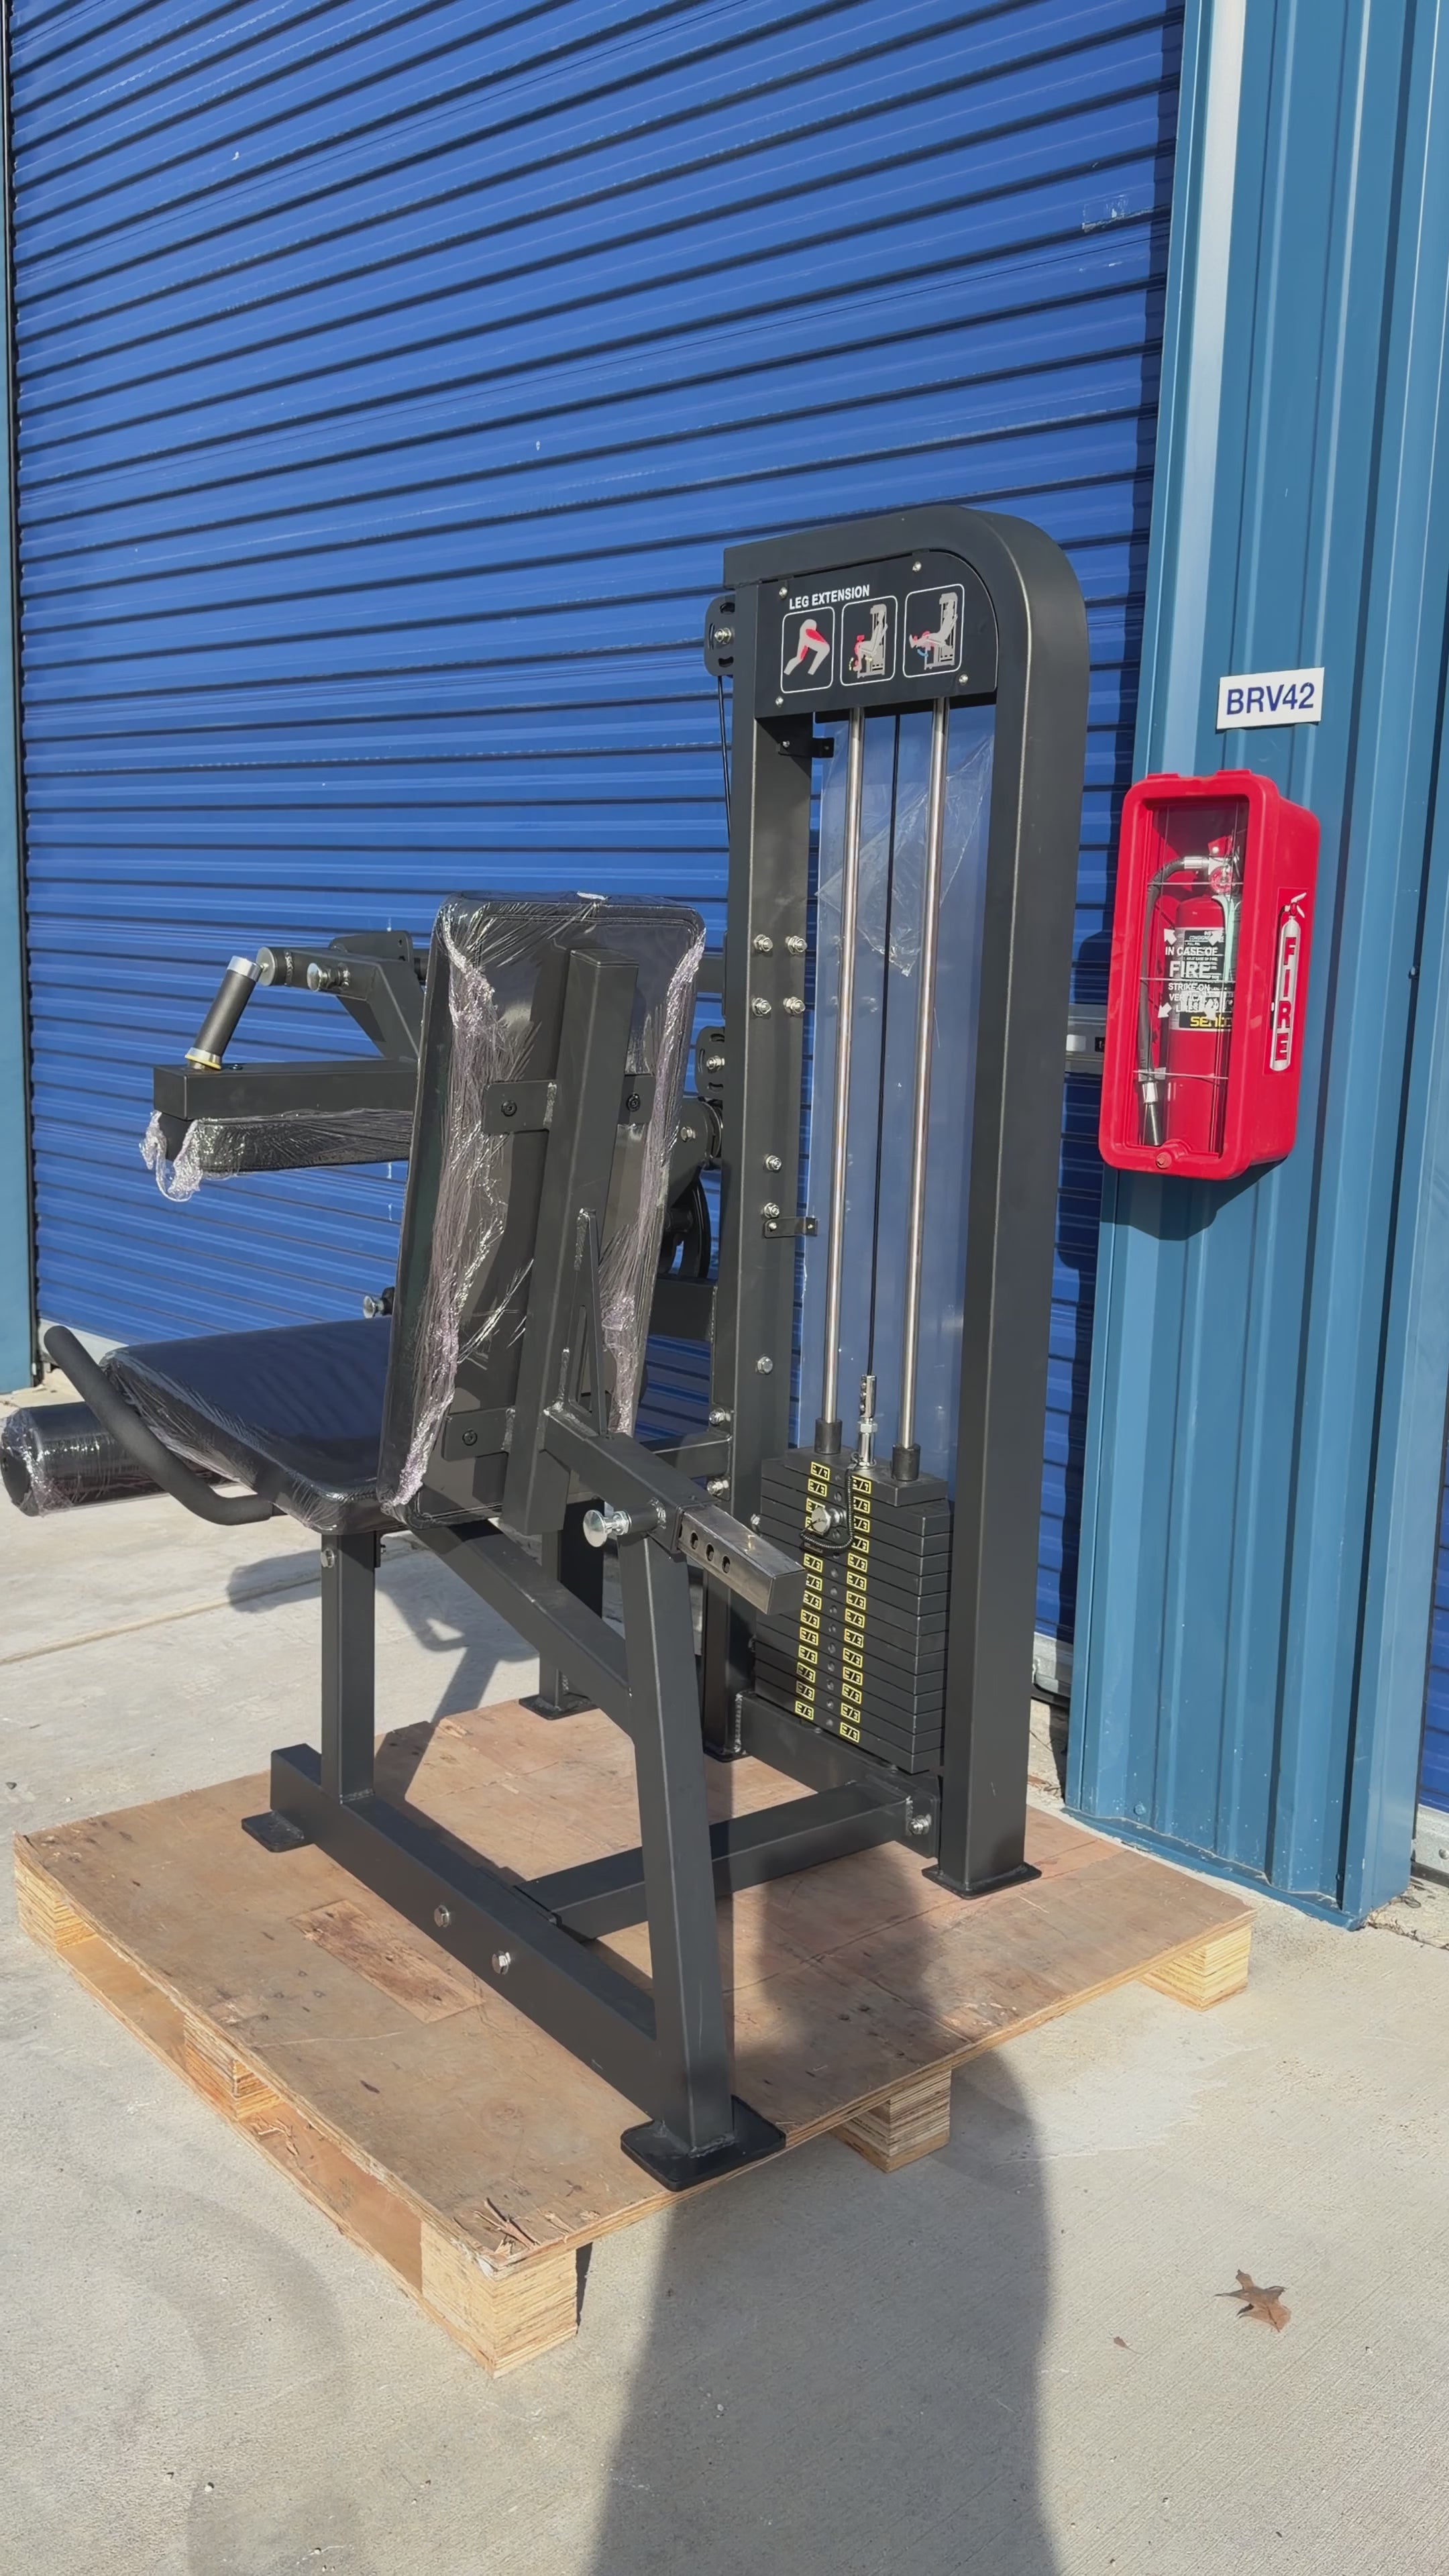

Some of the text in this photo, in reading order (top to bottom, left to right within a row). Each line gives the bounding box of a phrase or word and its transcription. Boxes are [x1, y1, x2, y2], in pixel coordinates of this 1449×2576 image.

[790, 584, 870, 610] LEG EXTENSION
[1226, 682, 1315, 715] BRV42
[1165, 946, 1175, 956] IN
[1177, 947, 1204, 956] CASE
[1169, 961, 1211, 979] FIRE
[1168, 983, 1210, 991] STRIKE ON
[1275, 937, 1297, 1061] FIRE
